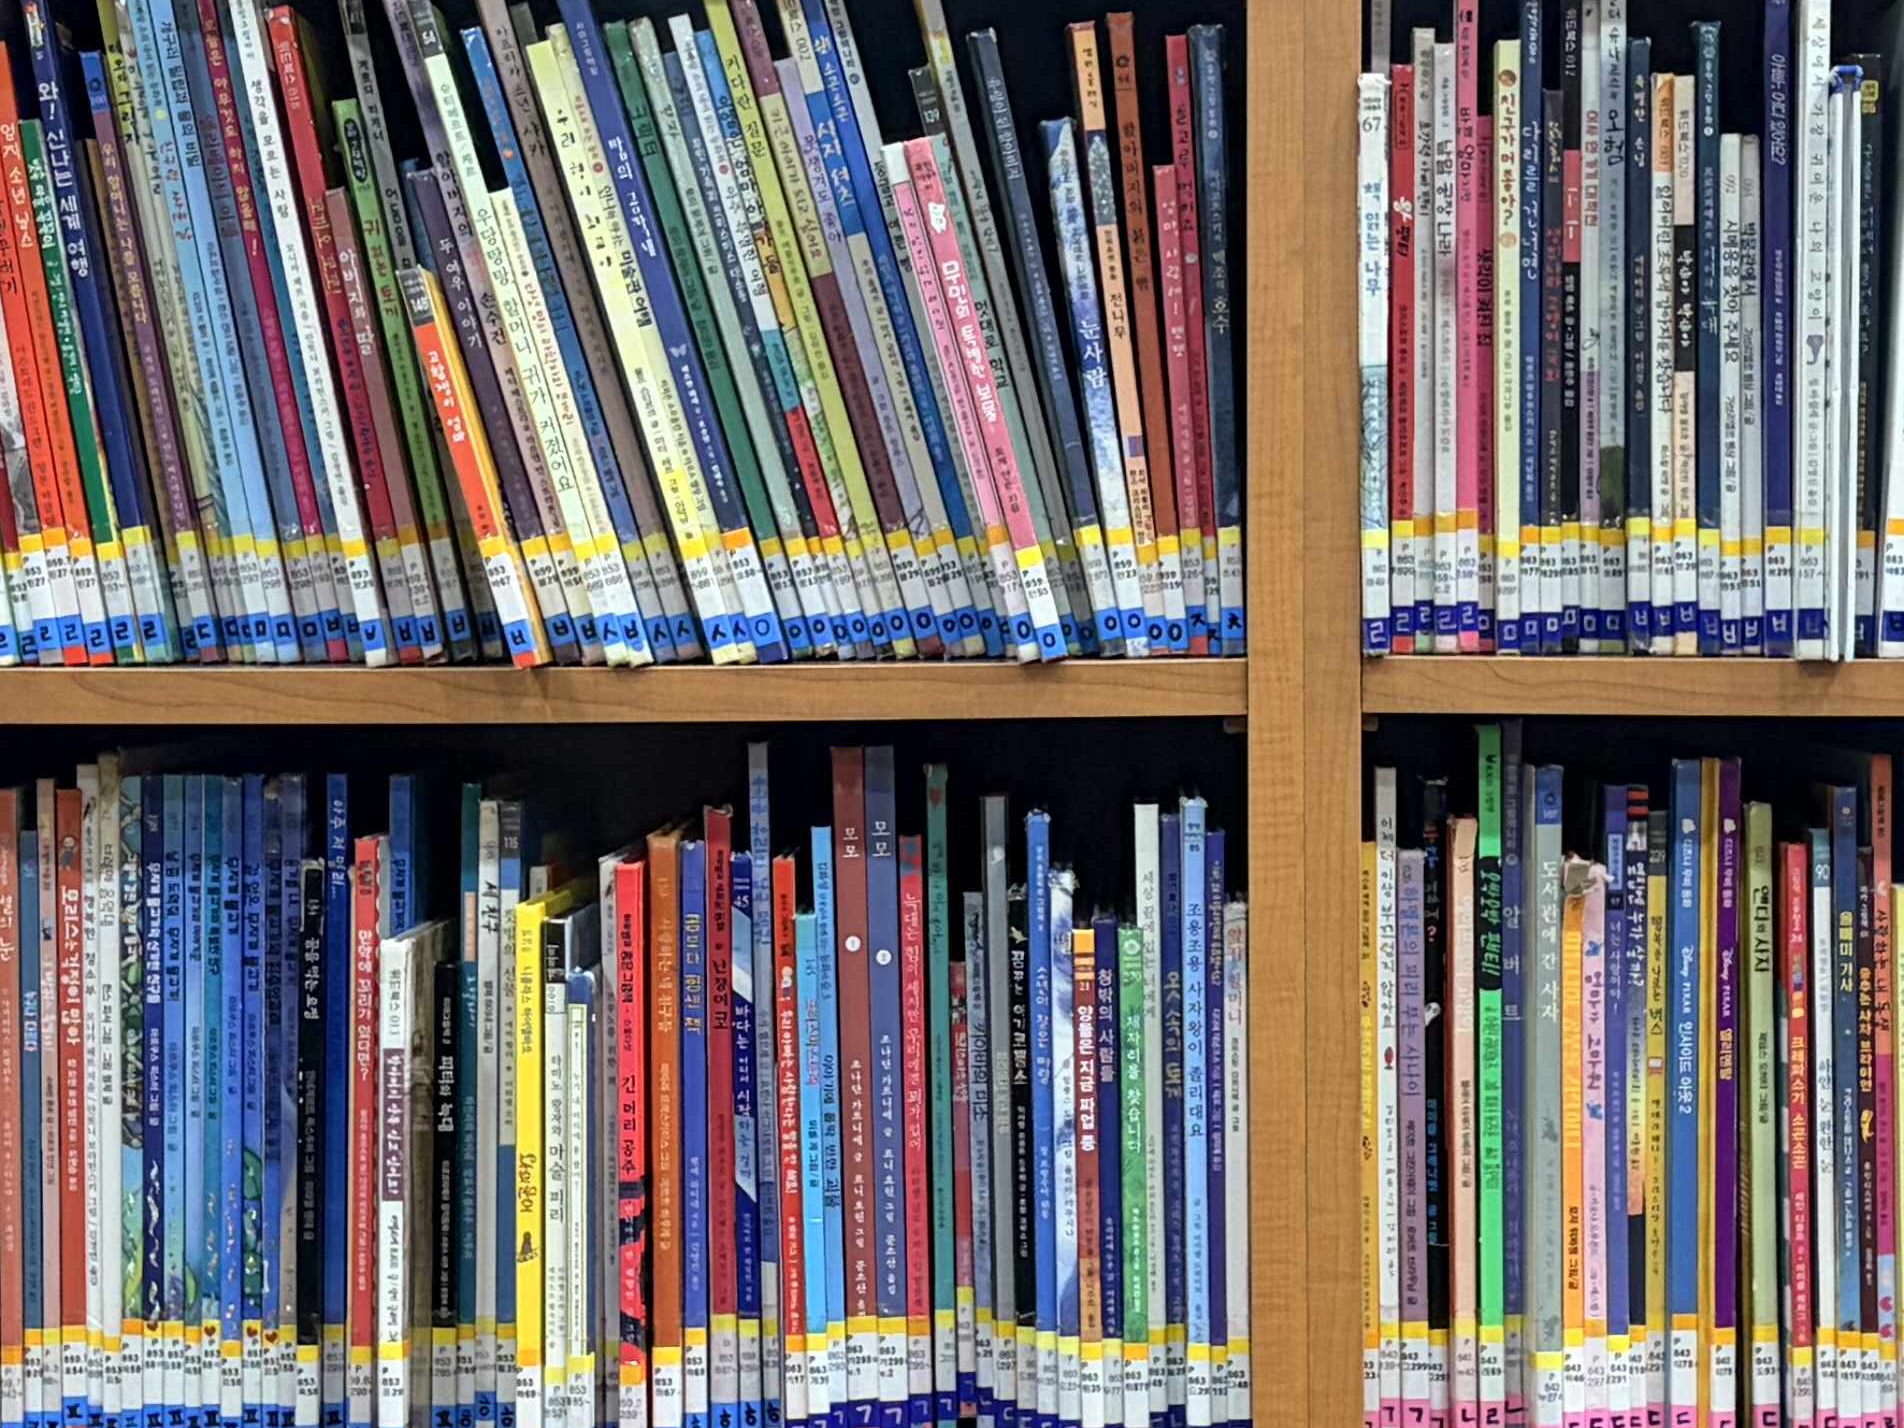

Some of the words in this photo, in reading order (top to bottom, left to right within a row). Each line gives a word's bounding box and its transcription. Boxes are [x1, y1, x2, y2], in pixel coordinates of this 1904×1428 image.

[37, 82, 58, 120] 와!
[1362, 116, 1382, 132] 67
[46, 131, 73, 188] 신나는
[250, 79, 269, 125] 생각을
[274, 189, 289, 219] 사람
[60, 194, 82, 231] 세계
[67, 241, 88, 277] 여행
[1080, 319, 1106, 389] 눈사람
[842, 828, 860, 859] 모모
[871, 820, 892, 858] 모모
[483, 880, 499, 901] 세
[1540, 861, 1559, 937] 도서관에
[481, 909, 500, 935] 친구
[1186, 903, 1204, 973] 조용조용
[1541, 951, 1557, 970] 간
[1186, 981, 1205, 1055] 사자왕이
[1540, 979, 1561, 1022] 사자
[1077, 1006, 1095, 1053] 양들은
[621, 1074, 636, 1096] 긴
[1078, 1060, 1095, 1093] 지금
[622, 1102, 638, 1133] 머리
[1080, 1097, 1096, 1130] 파업
[1187, 1066, 1206, 1138] 졸리대요
[623, 1136, 639, 1175] 공주
[1081, 1134, 1095, 1152] 중
